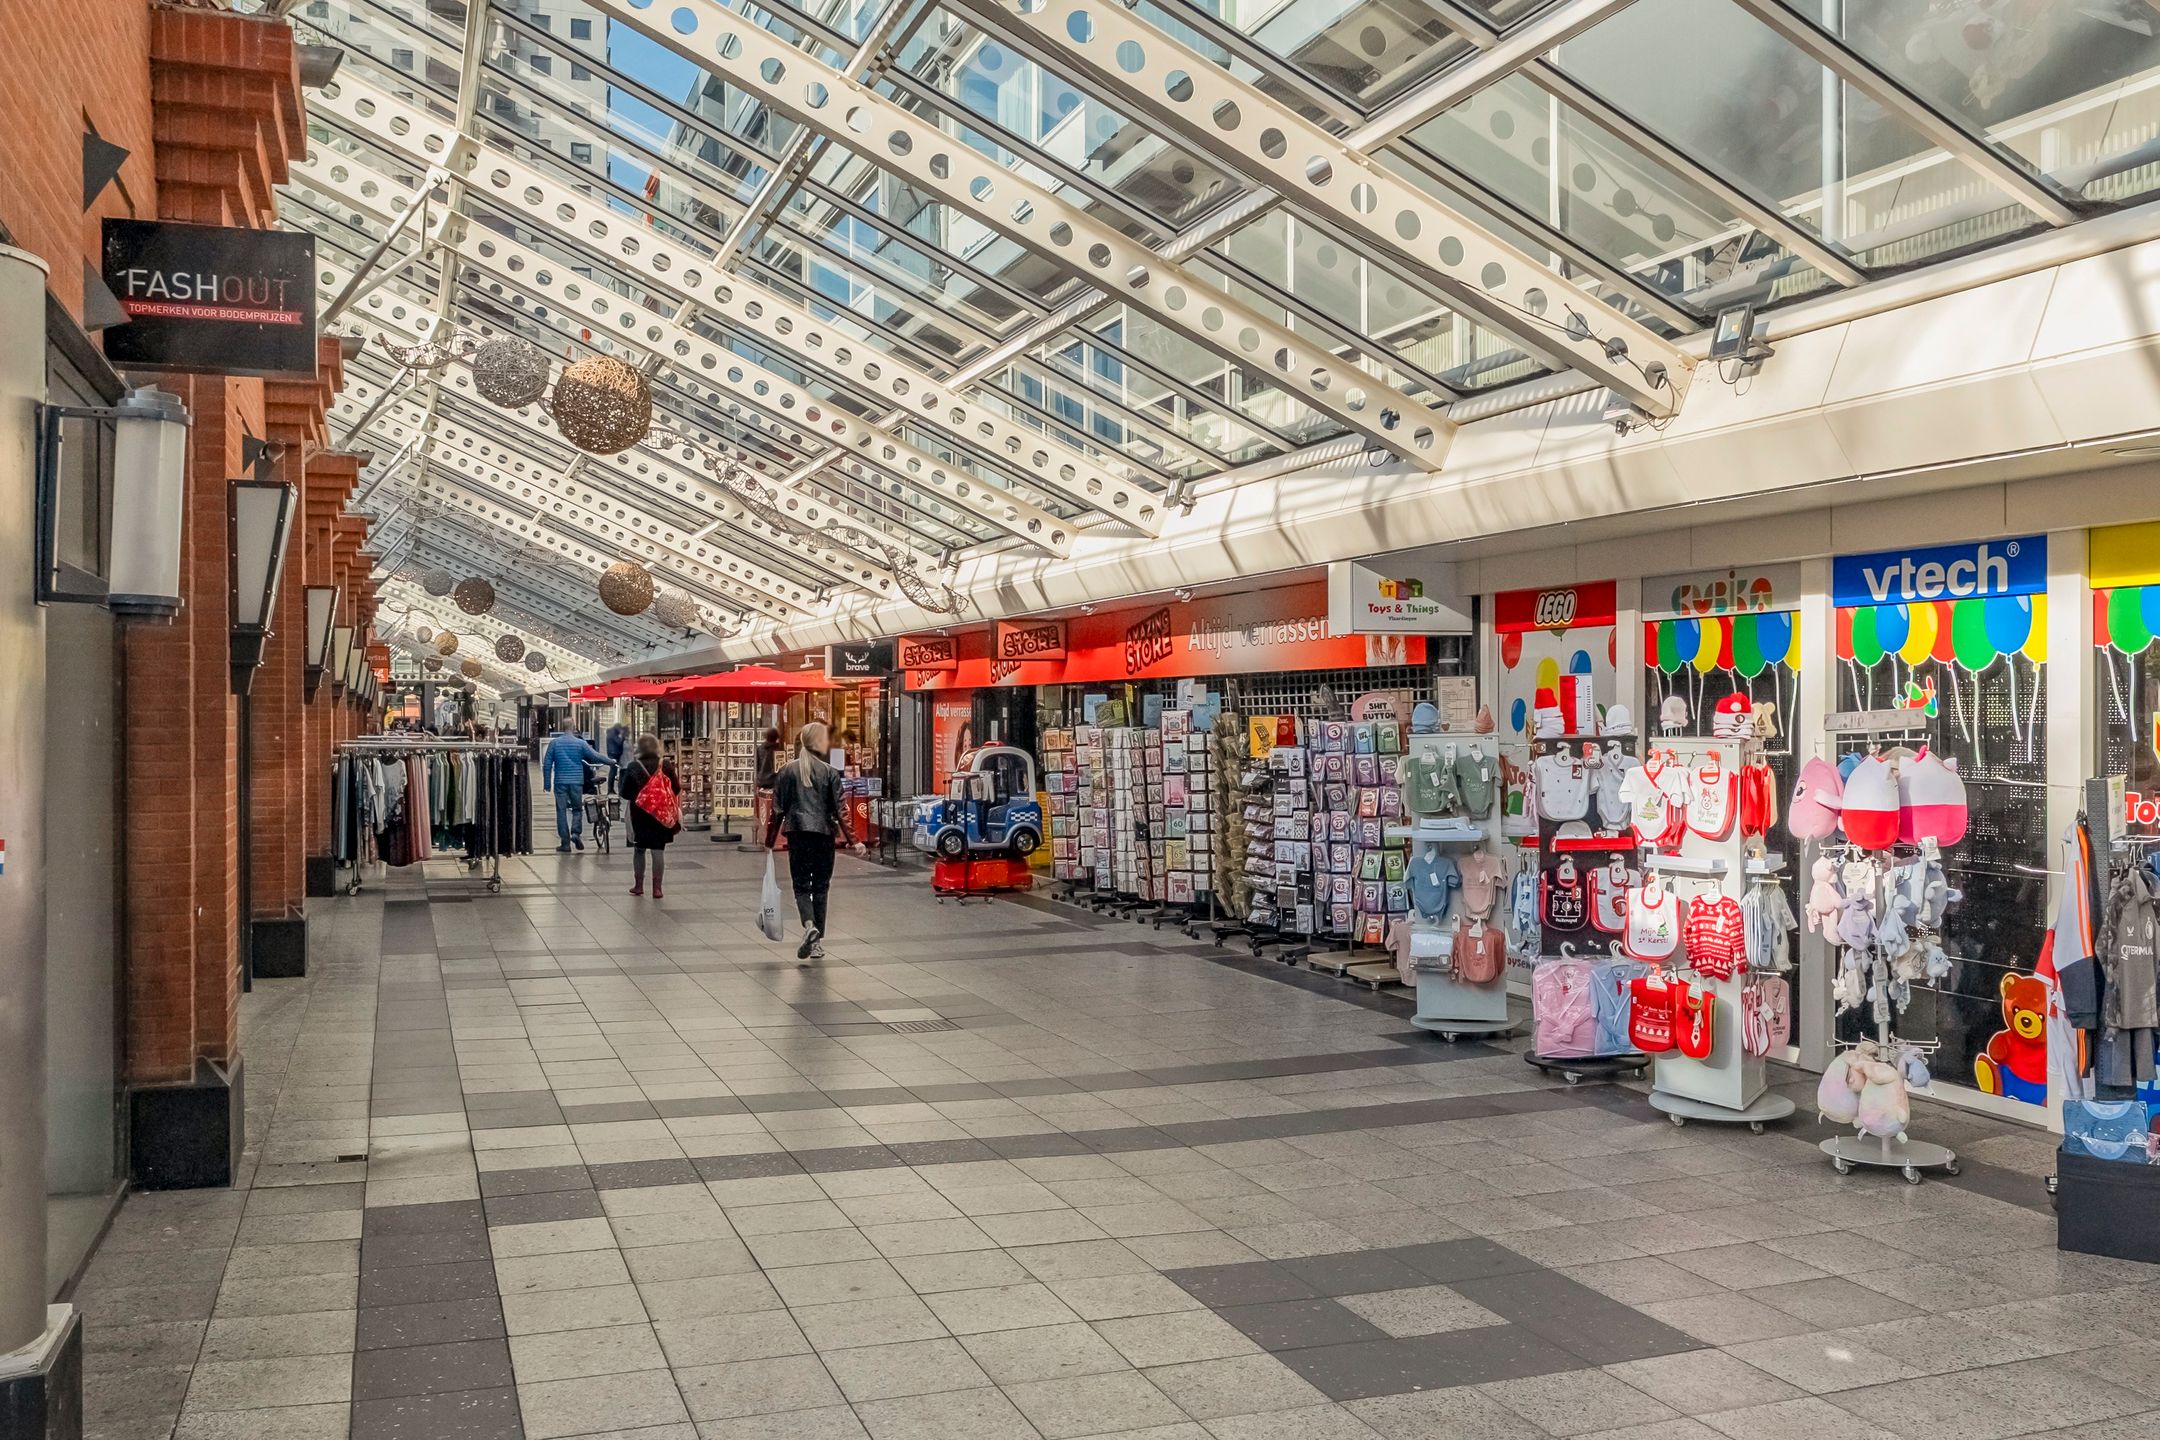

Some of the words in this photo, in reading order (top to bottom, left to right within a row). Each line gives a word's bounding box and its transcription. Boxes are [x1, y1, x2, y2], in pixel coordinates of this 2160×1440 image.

[128, 269, 291, 305] FASHOUT
[129, 302, 190, 316] TOPMERKEN
[191, 307, 218, 318] VOOR
[219, 309, 292, 322] BODEMPRIJZEN
[1368, 603, 1392, 614] Toys
[1394, 604, 1403, 613] &
[1406, 603, 1440, 615] Things
[1534, 590, 1578, 626] LEGO
[1126, 606, 1172, 641] AMAZING
[1004, 626, 1059, 643] AMAZING
[1188, 614, 1233, 659] Altijd
[1239, 614, 1347, 646] verrassen
[905, 641, 952, 656] AMAZING
[1004, 638, 1060, 657] STORE
[1126, 634, 1173, 675] STORE
[904, 650, 952, 667] STORE
[845, 663, 870, 671] brave
[936, 703, 949, 721] Altijd
[1369, 702, 1387, 710] SHIT
[1363, 712, 1396, 720] BUTTON
[1331, 729, 1338, 737] 3
[1330, 762, 1338, 770] 11
[1173, 820, 1183, 828] 60
[1366, 890, 1374, 898] 21
[1393, 889, 1403, 897] 20
[1640, 928, 1657, 938] Mijn
